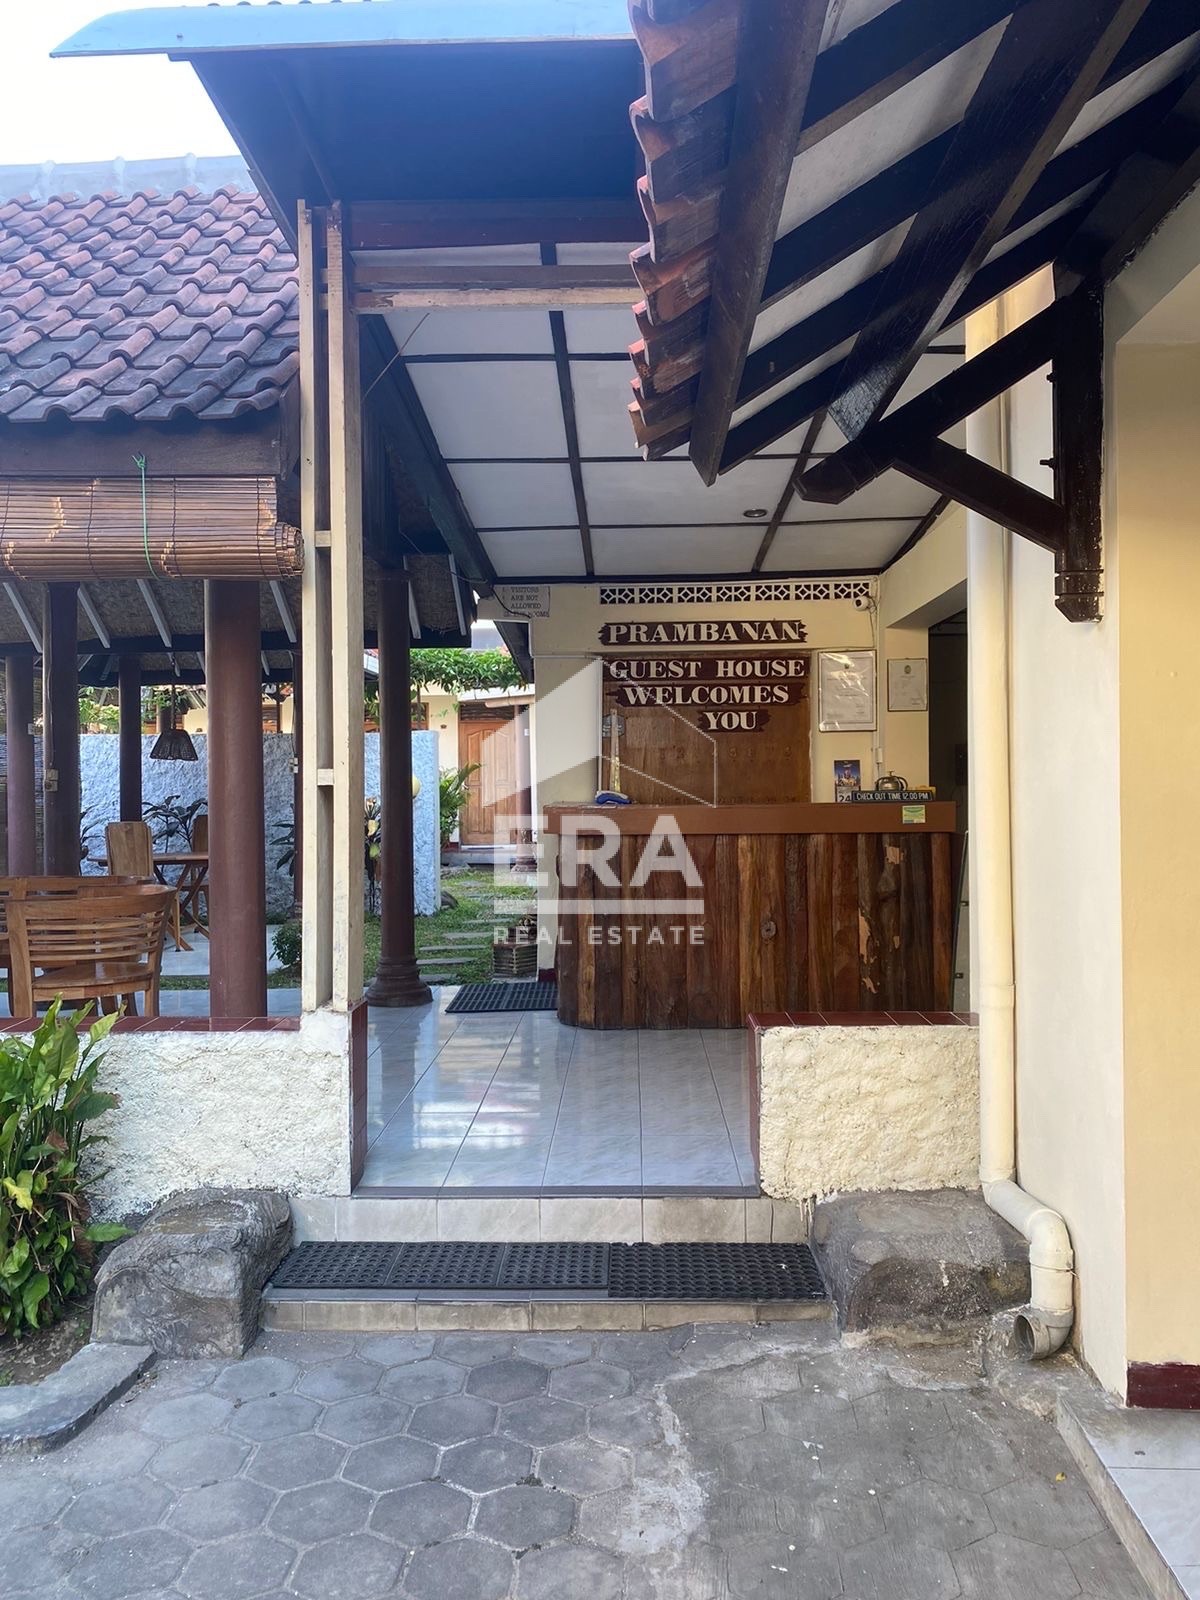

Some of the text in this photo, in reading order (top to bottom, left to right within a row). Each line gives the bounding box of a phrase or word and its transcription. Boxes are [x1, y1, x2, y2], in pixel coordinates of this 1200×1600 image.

[609, 622, 801, 643] PRAMBANAN
[609, 659, 805, 679] GUEST HOUSE
[623, 685, 789, 705] WELCOMES
[704, 711, 758, 730] YOU
[856, 792, 874, 801] CHECK
[874, 792, 887, 800] OUT
[888, 792, 902, 800] TIME
[918, 792, 929, 800] PM
